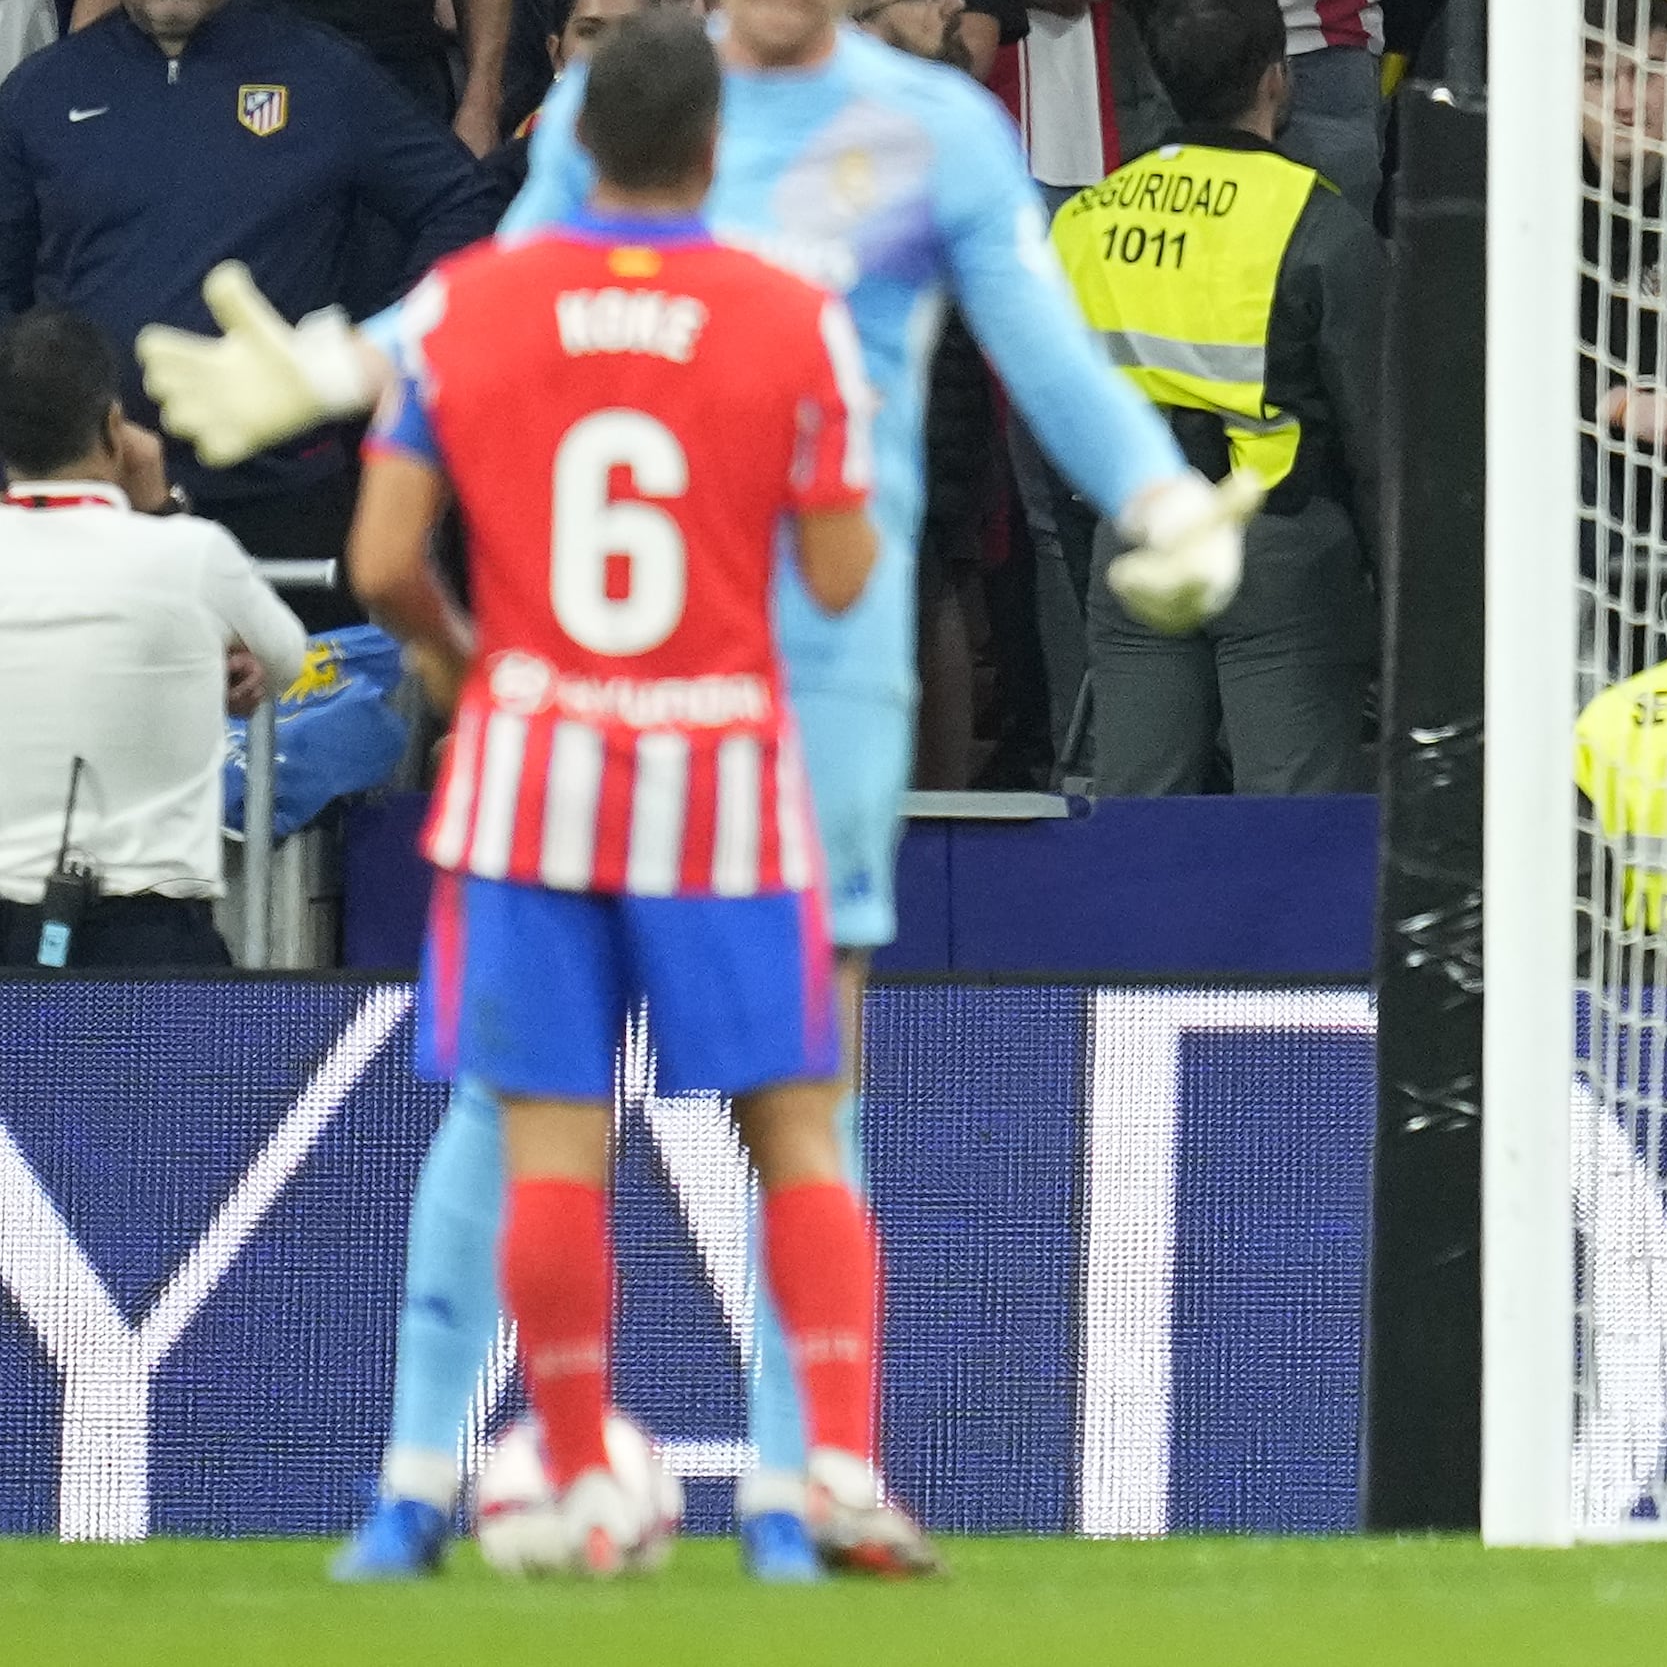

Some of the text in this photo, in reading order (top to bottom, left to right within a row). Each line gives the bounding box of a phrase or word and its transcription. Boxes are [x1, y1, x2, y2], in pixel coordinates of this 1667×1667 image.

[1102, 222, 1187, 269] 1011
[555, 287, 710, 364] KOKE
[550, 406, 689, 657] 6
